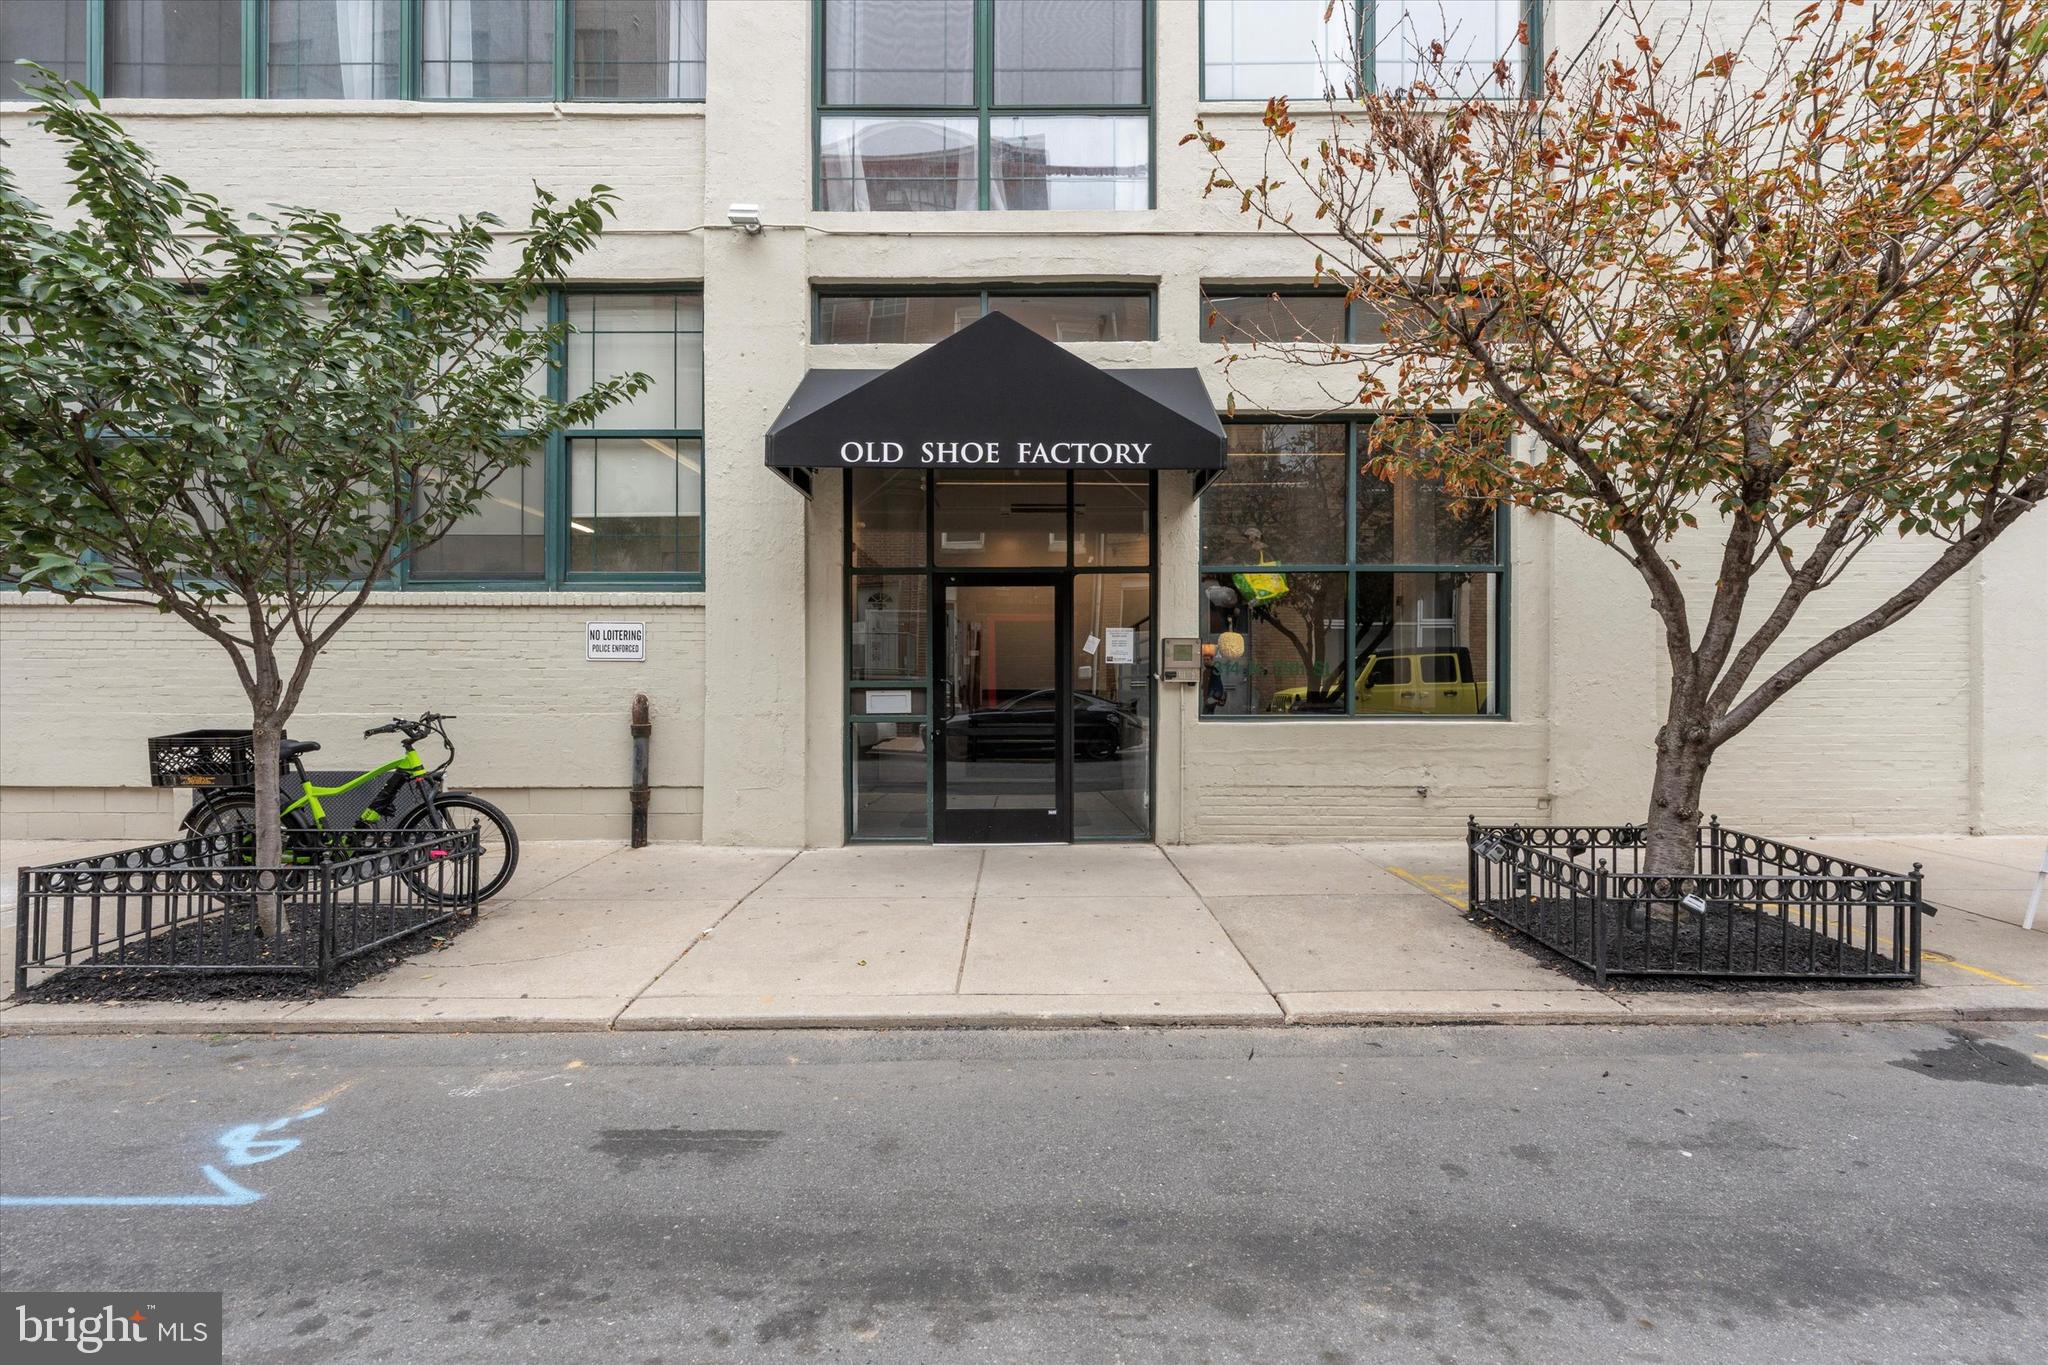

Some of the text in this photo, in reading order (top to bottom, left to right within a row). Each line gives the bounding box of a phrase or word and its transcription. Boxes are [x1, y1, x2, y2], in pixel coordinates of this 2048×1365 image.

[840, 441, 1152, 464] OLD SHOE FACTORY
[590, 630, 642, 641] NO LOITERING
[592, 644, 639, 653] POLICE ENFORCED
